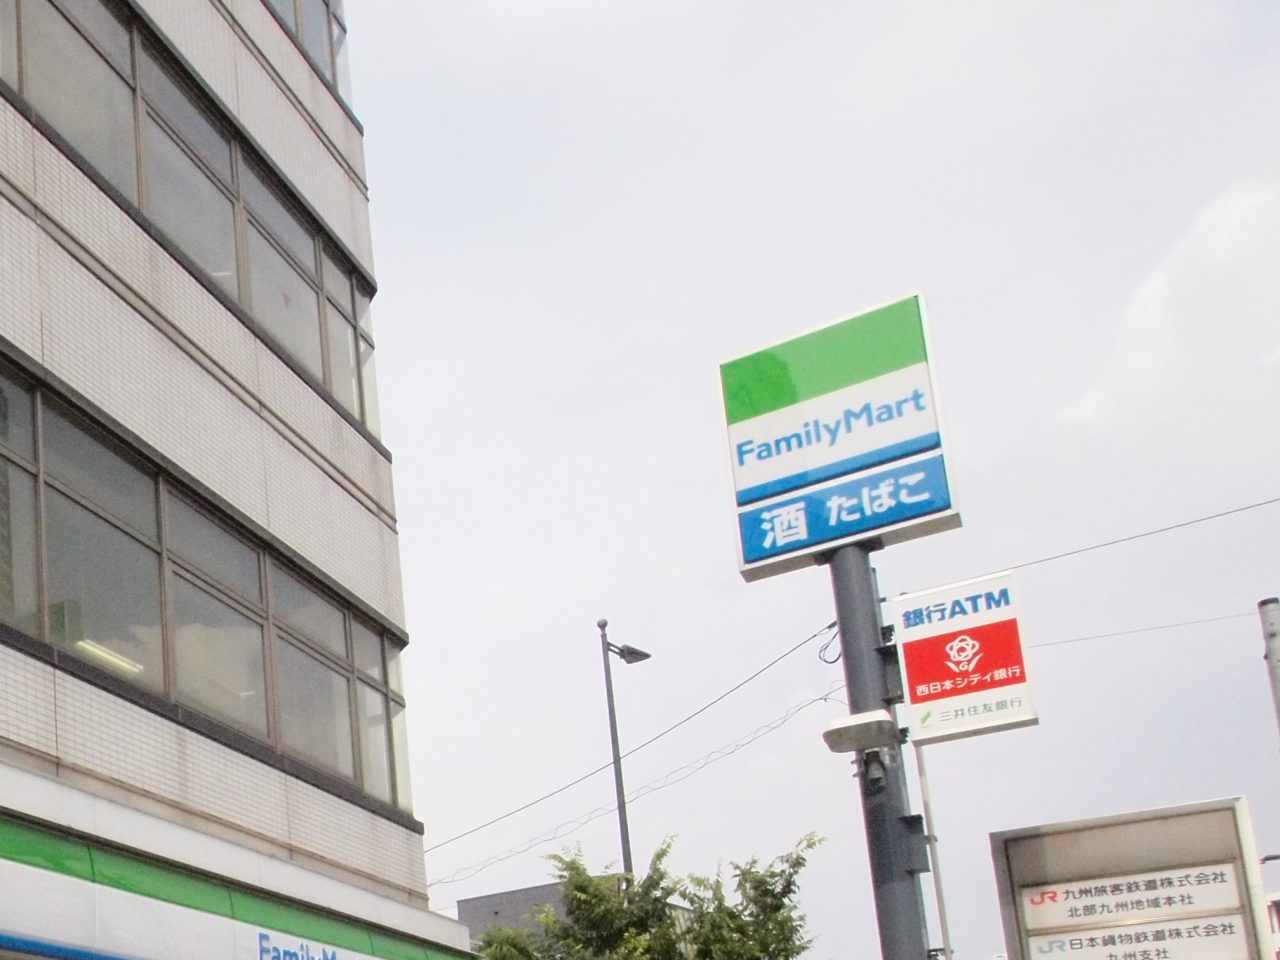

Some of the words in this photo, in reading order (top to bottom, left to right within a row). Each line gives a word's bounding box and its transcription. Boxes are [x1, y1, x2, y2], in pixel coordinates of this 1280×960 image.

[736, 389, 927, 466] FamilyMart
[761, 501, 808, 550] 酒
[826, 472, 930, 527] たばこ
[903, 587, 1012, 629] 銀行ATM
[916, 665, 1022, 697] 西日本シティ銀行
[939, 696, 1024, 723] 三井住友銀行
[1030, 890, 1058, 906] JR
[1063, 870, 1228, 902] 九州旅客鉄道株式会社
[1068, 893, 1195, 919] 北部九州地域本社
